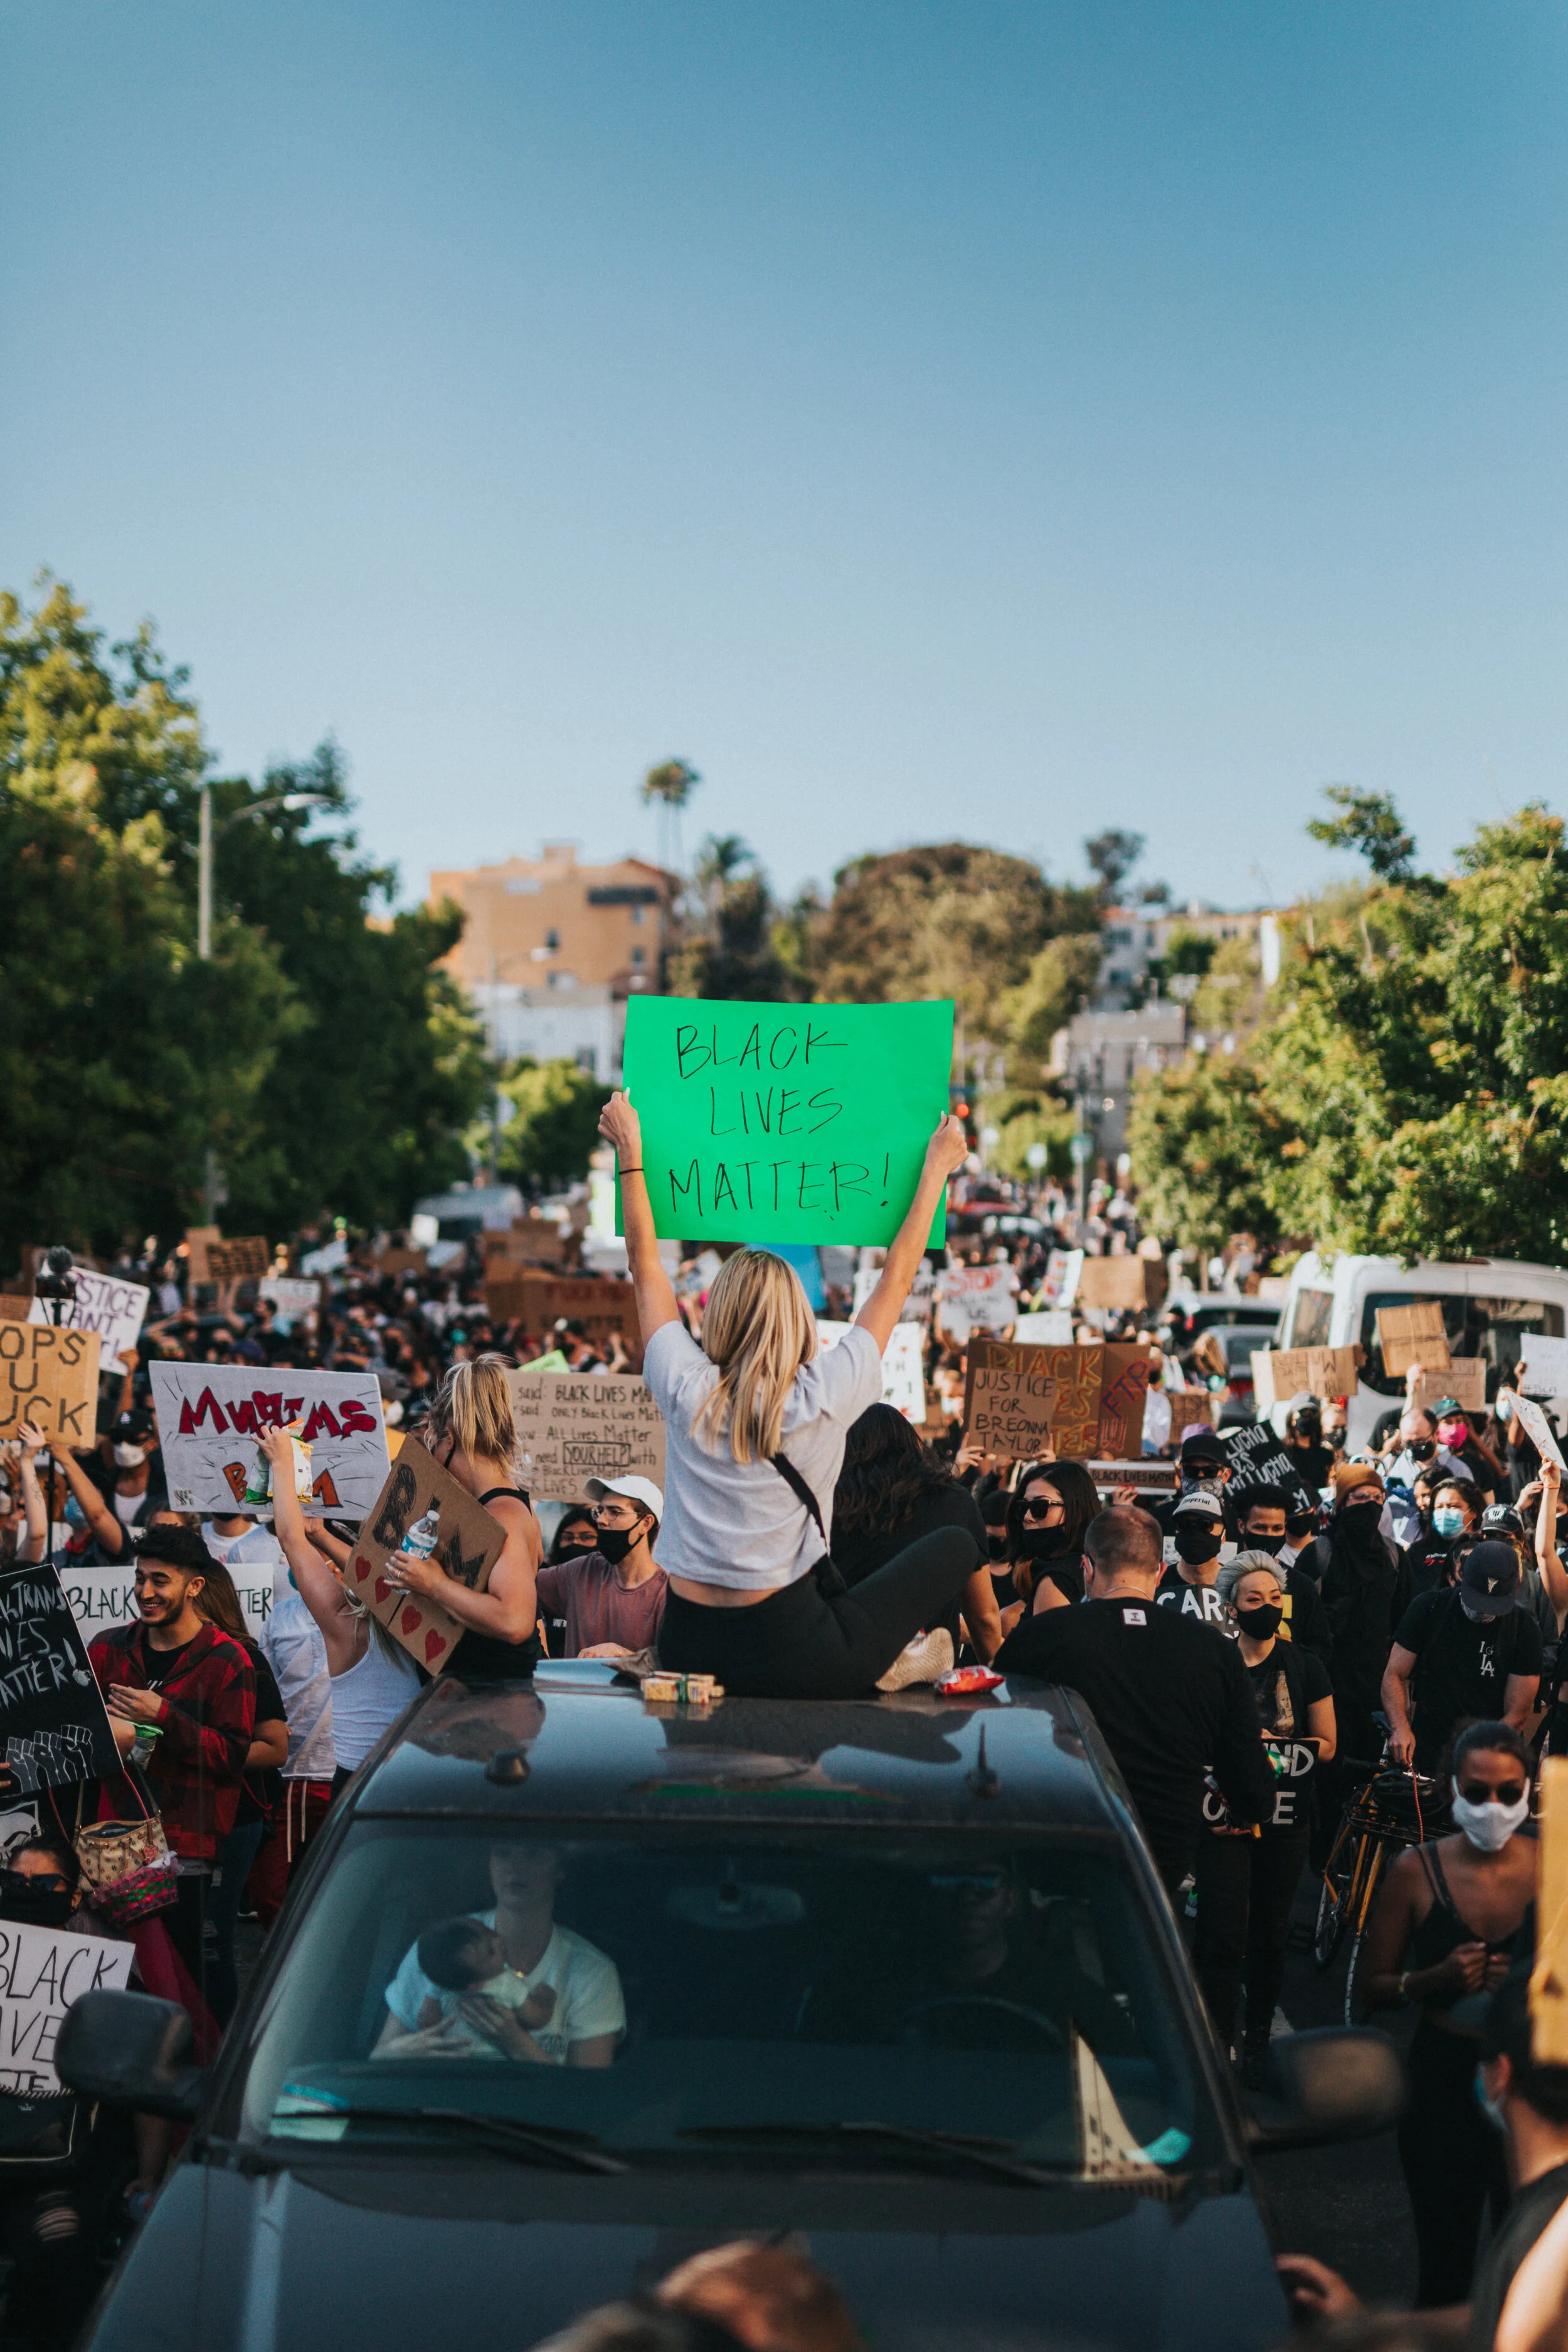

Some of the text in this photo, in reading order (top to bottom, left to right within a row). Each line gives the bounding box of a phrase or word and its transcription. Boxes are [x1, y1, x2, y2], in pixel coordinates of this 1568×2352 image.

[677, 1022, 849, 1079] BLACK
[710, 1086, 843, 1135] LIVES
[668, 1152, 889, 1219] MATTER!
[948, 1267, 1003, 1297] STOP
[555, 1384, 590, 1402] BLACK
[594, 1385, 626, 1403] LIVES
[975, 1371, 1057, 1399] JUSTICE
[1101, 1358, 1152, 1420] FTP
[551, 1407, 577, 1419] ONLY
[990, 1396, 1027, 1414] FOR
[603, 1424, 652, 1442] Matter
[975, 1413, 1051, 1436] BREONNA
[535, 1444, 657, 1466] need YOUR HELP with
[978, 1431, 1042, 1454] TAYLOR
[1091, 1470, 1122, 1482] BLACK
[1123, 1470, 1147, 1483] LIVES
[11, 1580, 68, 1619] TRANS
[67, 1586, 140, 1622] BLACK
